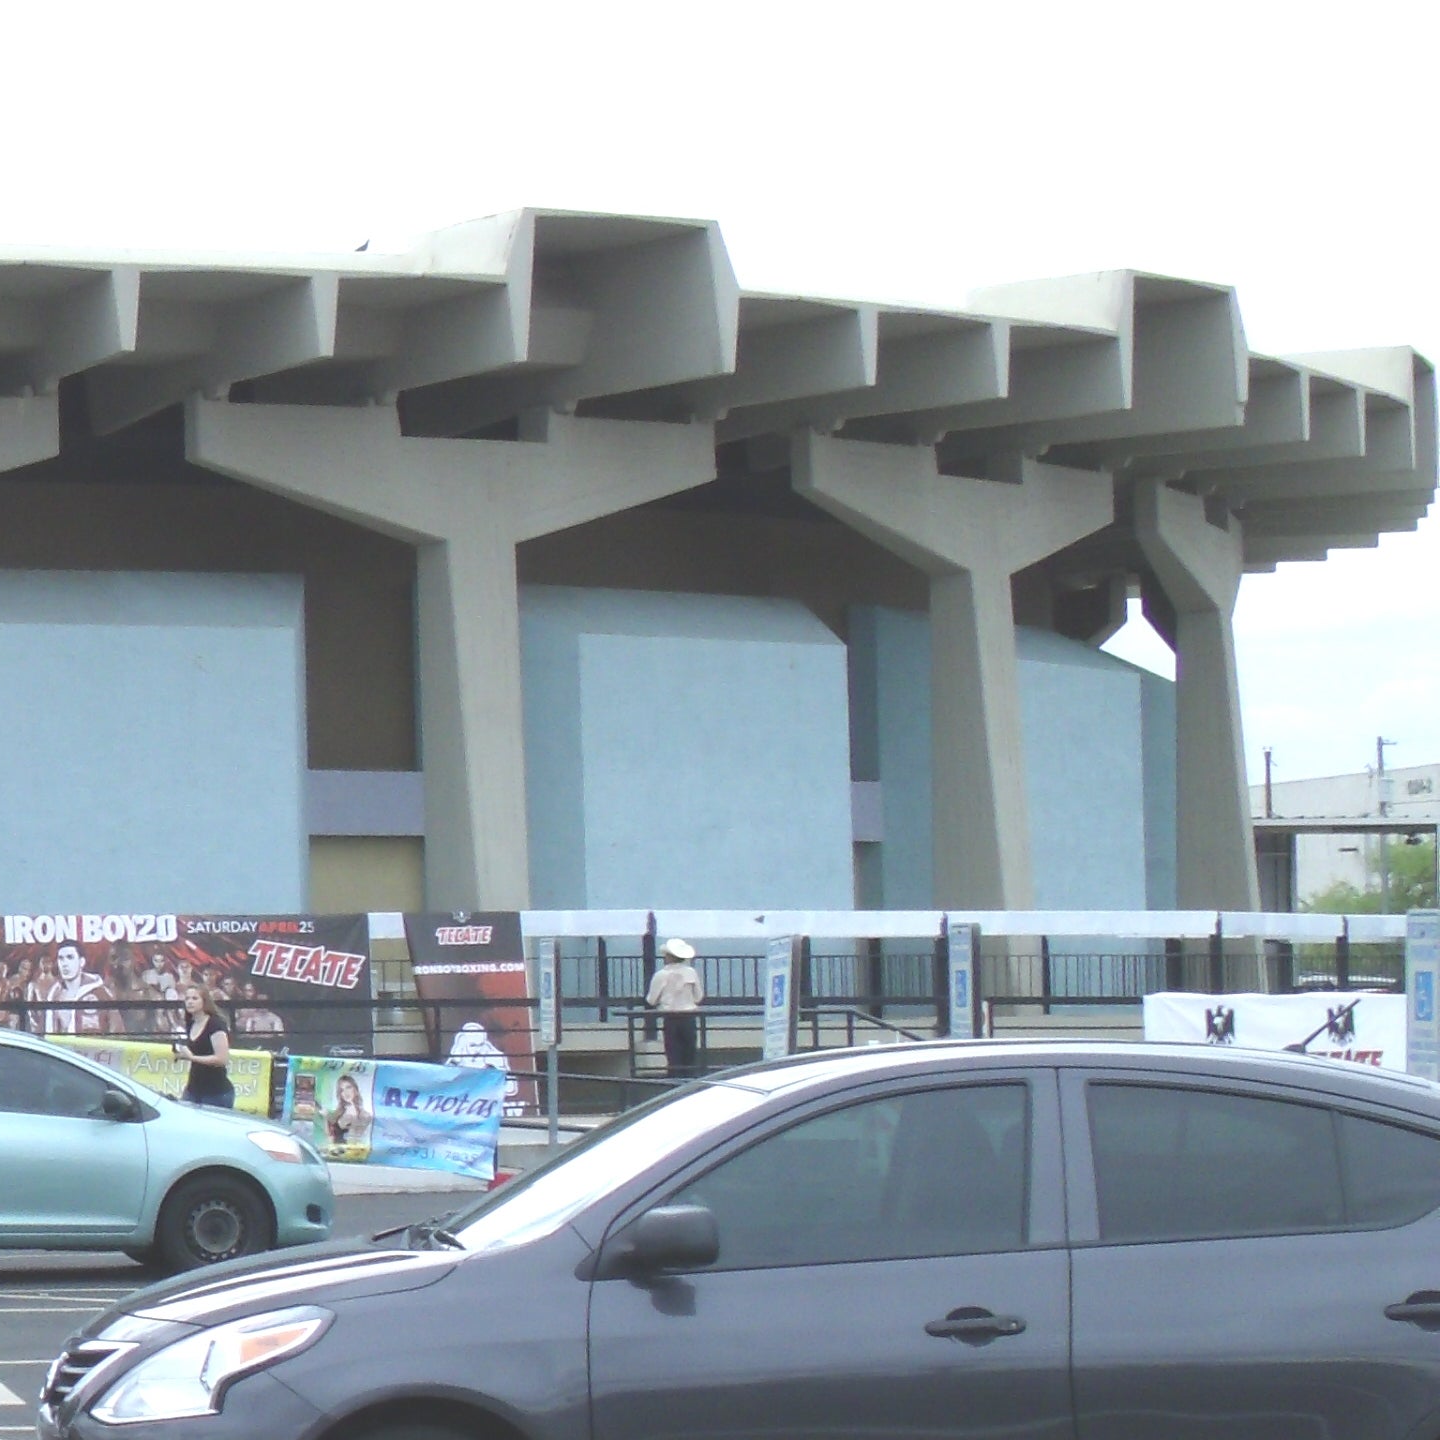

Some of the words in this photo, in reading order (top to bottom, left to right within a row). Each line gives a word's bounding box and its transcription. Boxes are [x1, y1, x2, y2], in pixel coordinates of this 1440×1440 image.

[3, 914, 79, 945] IRON
[186, 921, 258, 934] SATURDAY
[299, 920, 315, 933] 25
[436, 926, 493, 946] TECATE
[248, 938, 366, 990] TECATE
[384, 1086, 420, 1110] AZ
